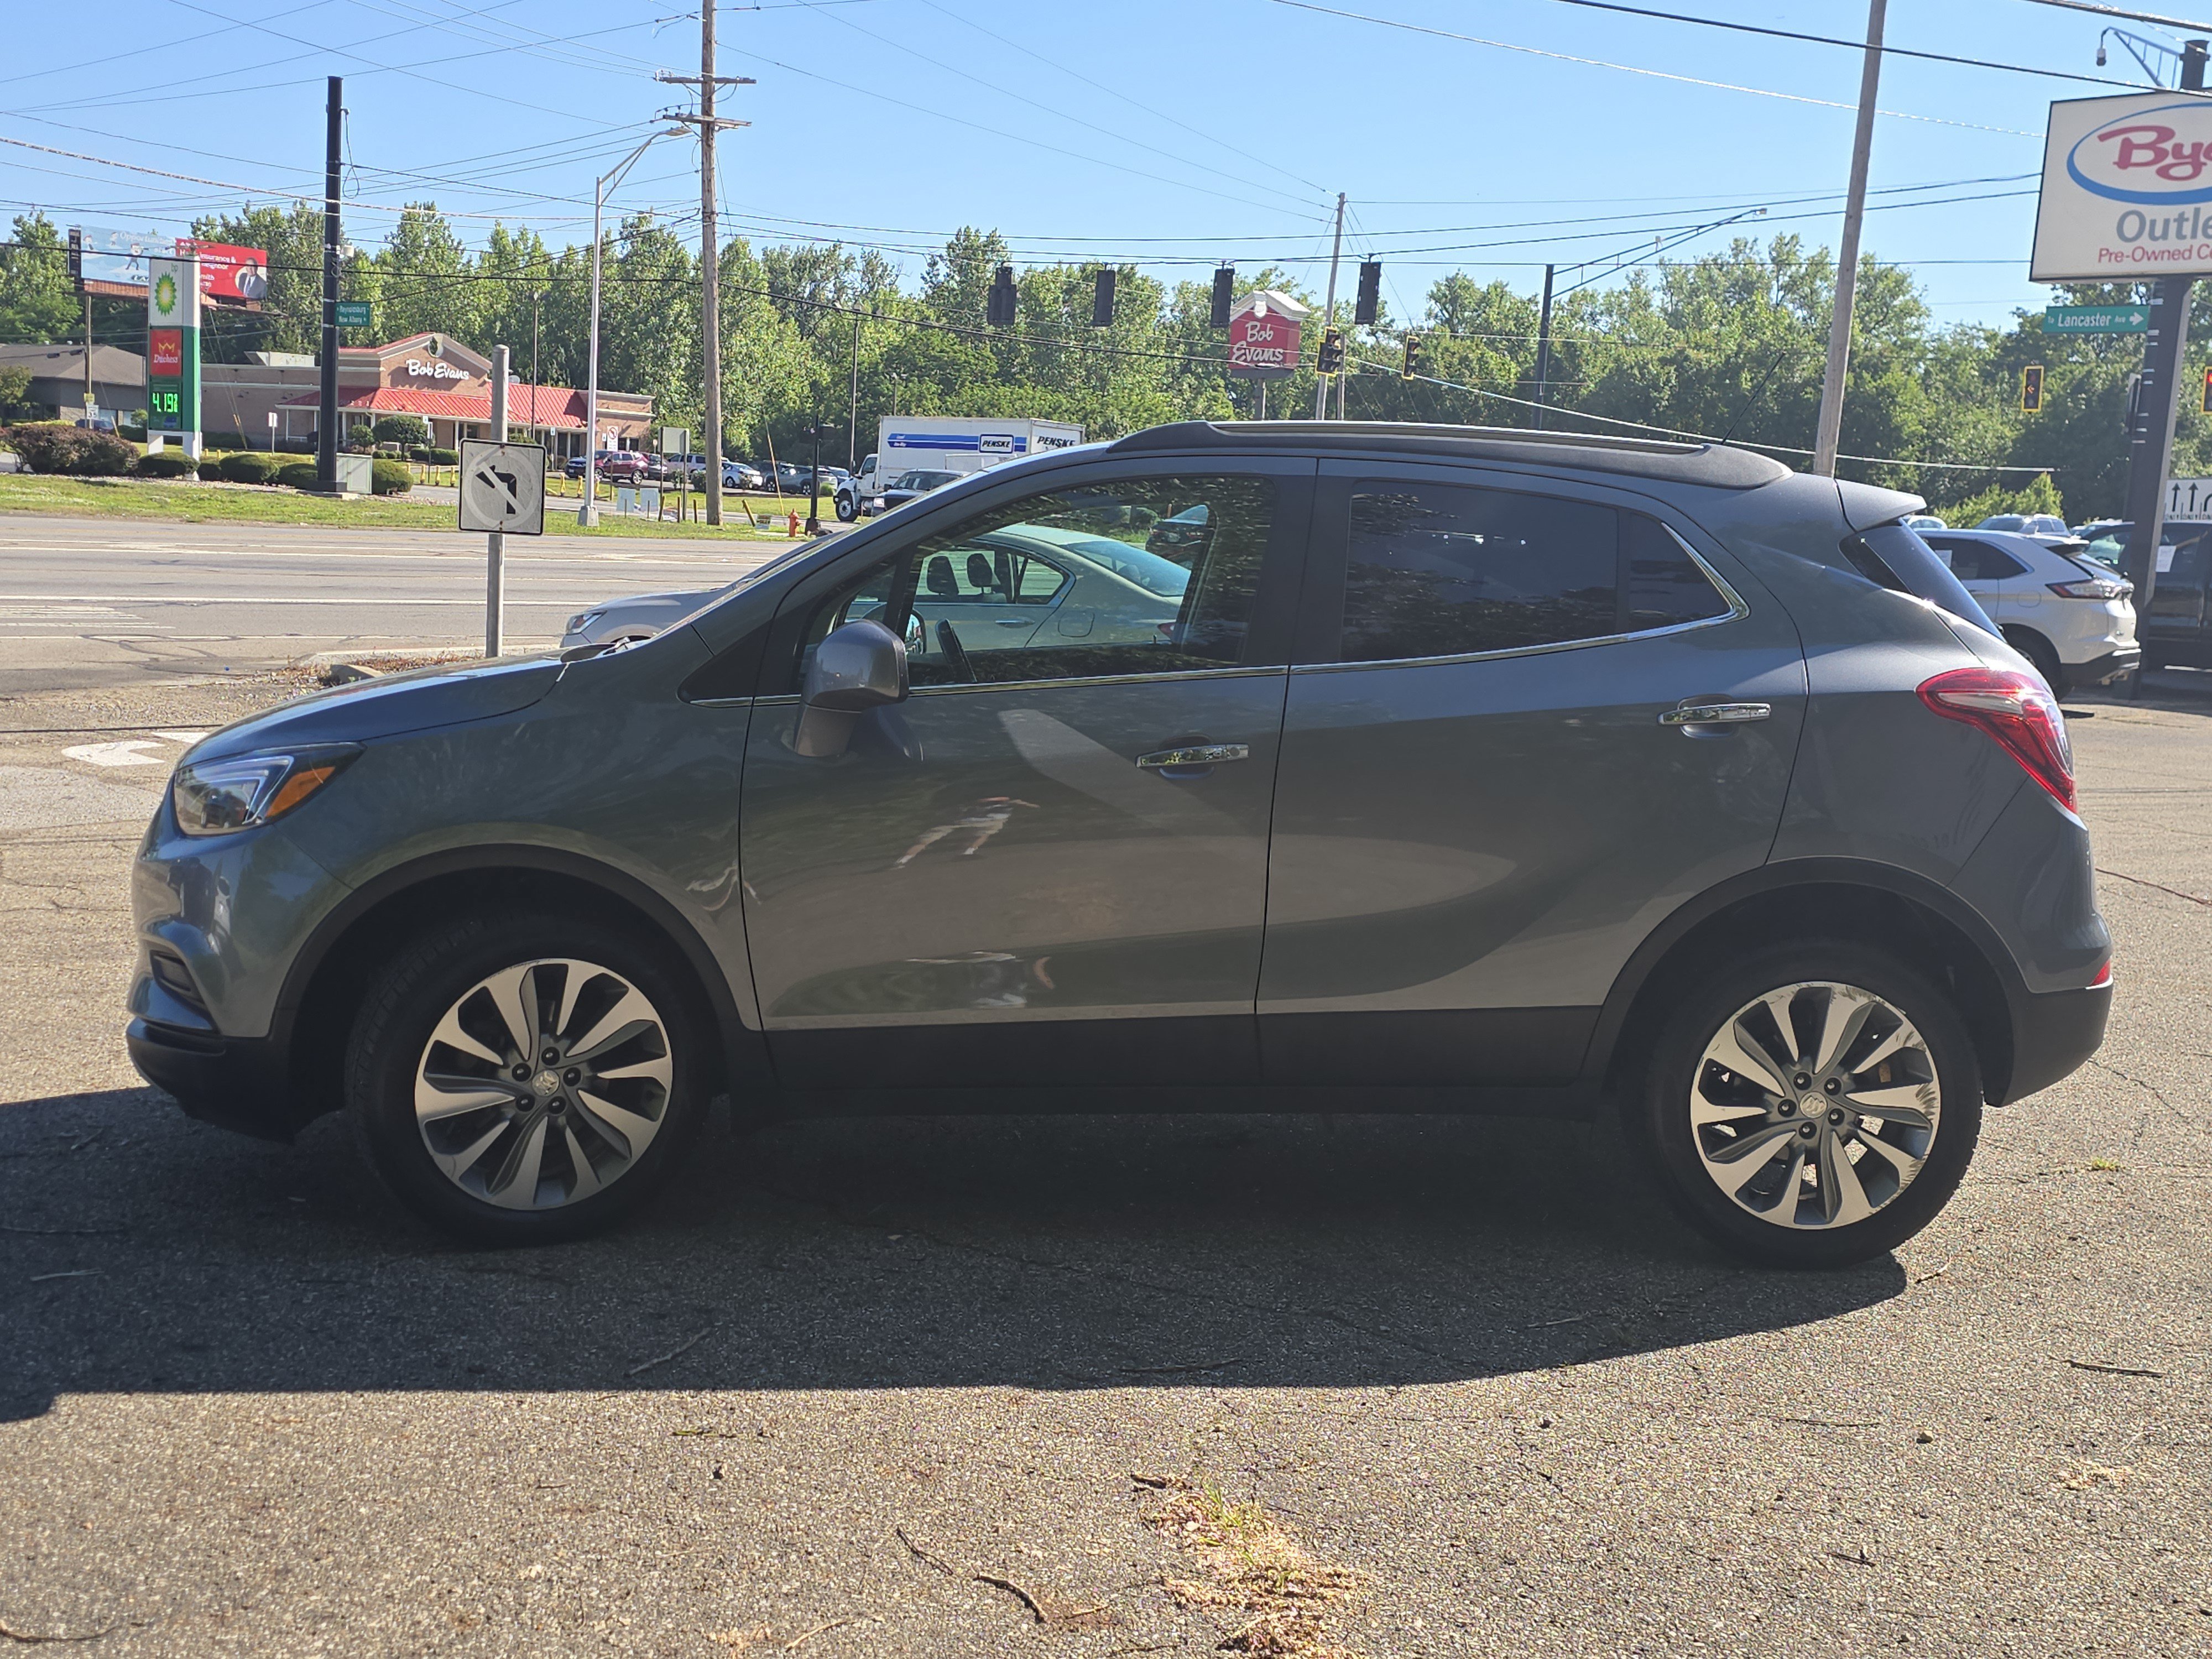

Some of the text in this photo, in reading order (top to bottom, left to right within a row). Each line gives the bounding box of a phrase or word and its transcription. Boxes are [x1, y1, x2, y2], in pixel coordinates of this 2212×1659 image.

[2098, 245, 2193, 263] Pre-Owned
[2058, 312, 2111, 327] Lancaster
[1245, 321, 1274, 342] Bob
[1232, 341, 1283, 362] Evans
[405, 359, 469, 380] Bob Evans
